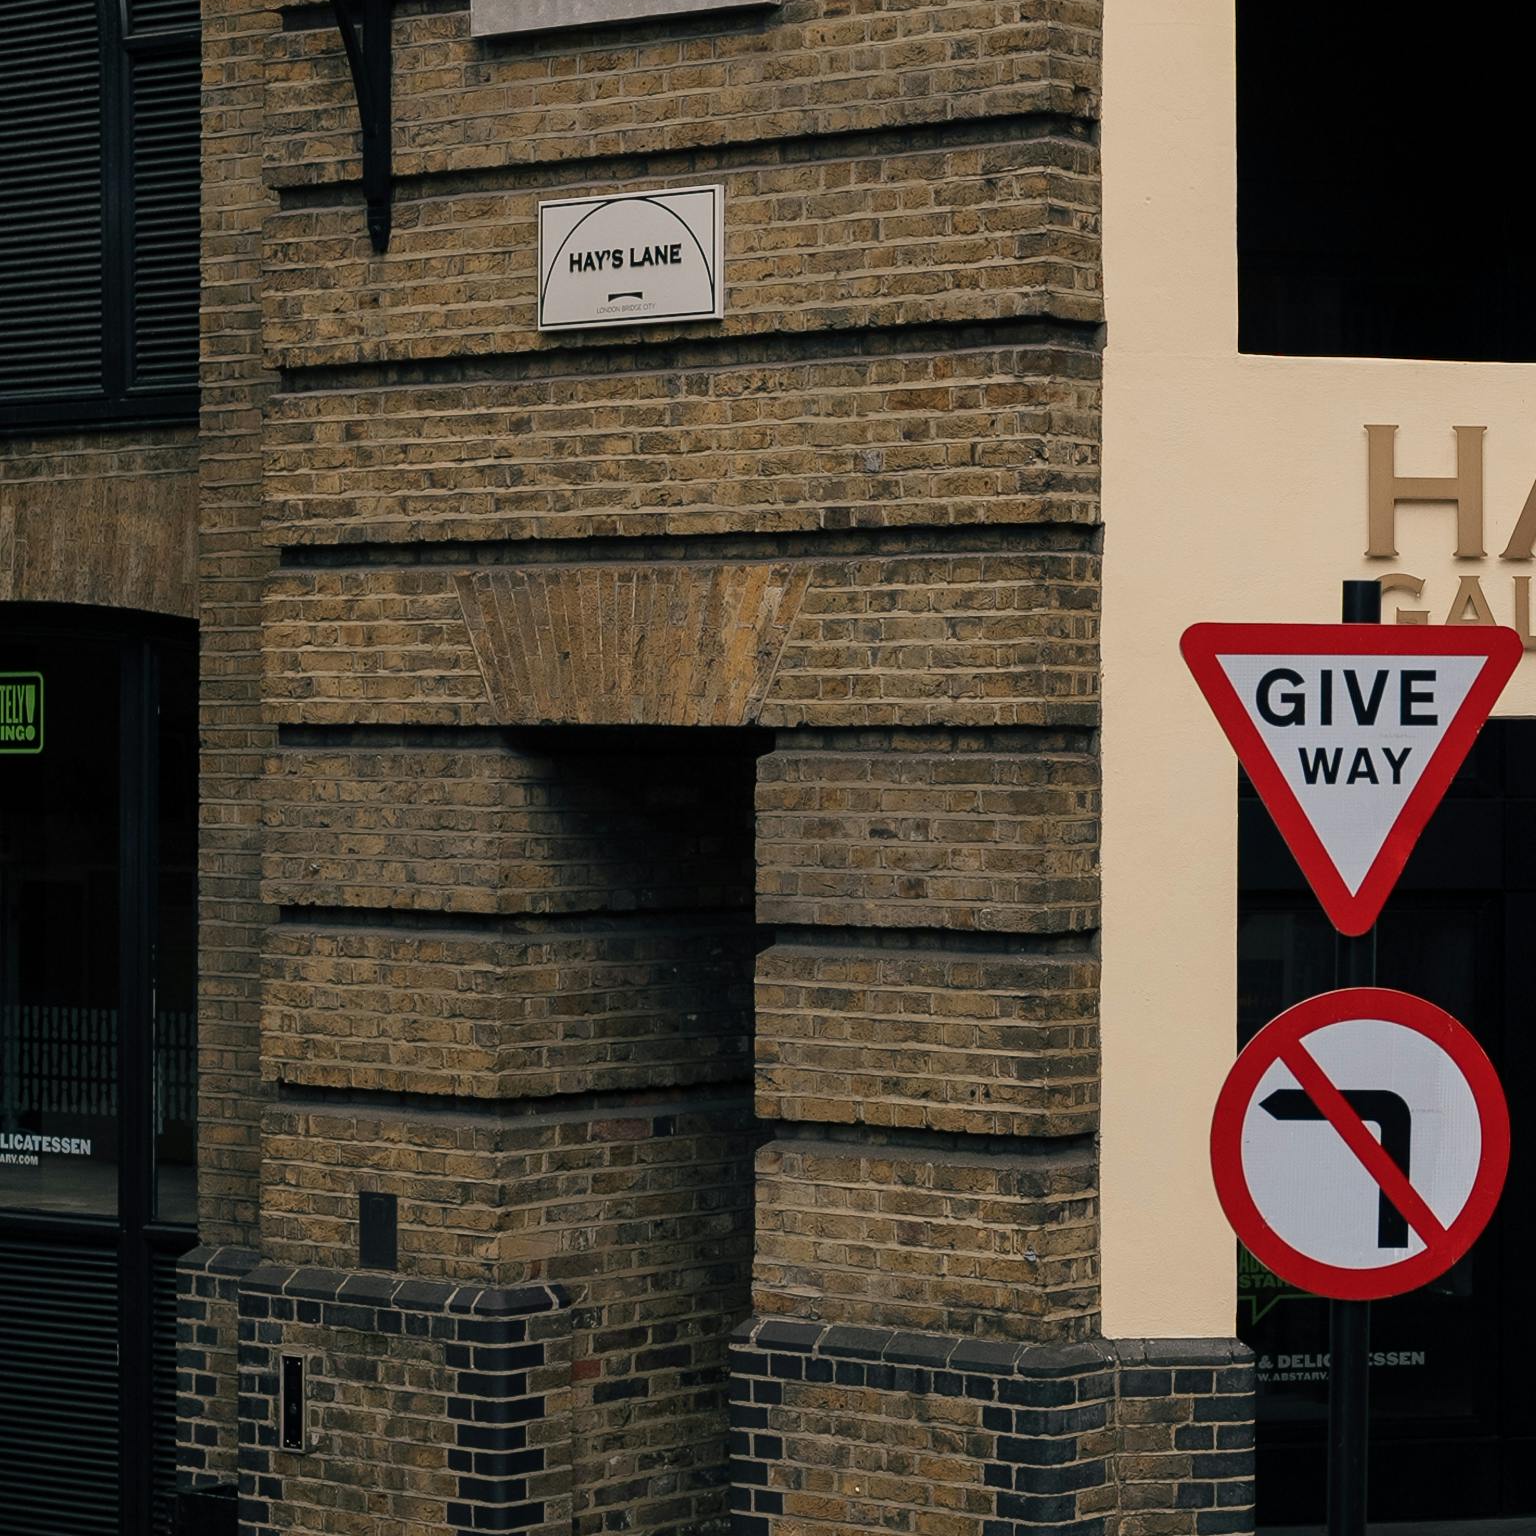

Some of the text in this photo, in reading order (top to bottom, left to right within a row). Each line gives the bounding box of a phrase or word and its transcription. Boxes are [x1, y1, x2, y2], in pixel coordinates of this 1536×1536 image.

[569, 243, 682, 273] HAY'S LANE
[1256, 668, 1438, 727] GIVE
[1298, 747, 1412, 784] WAY
[1258, 1354, 1274, 1369] &
